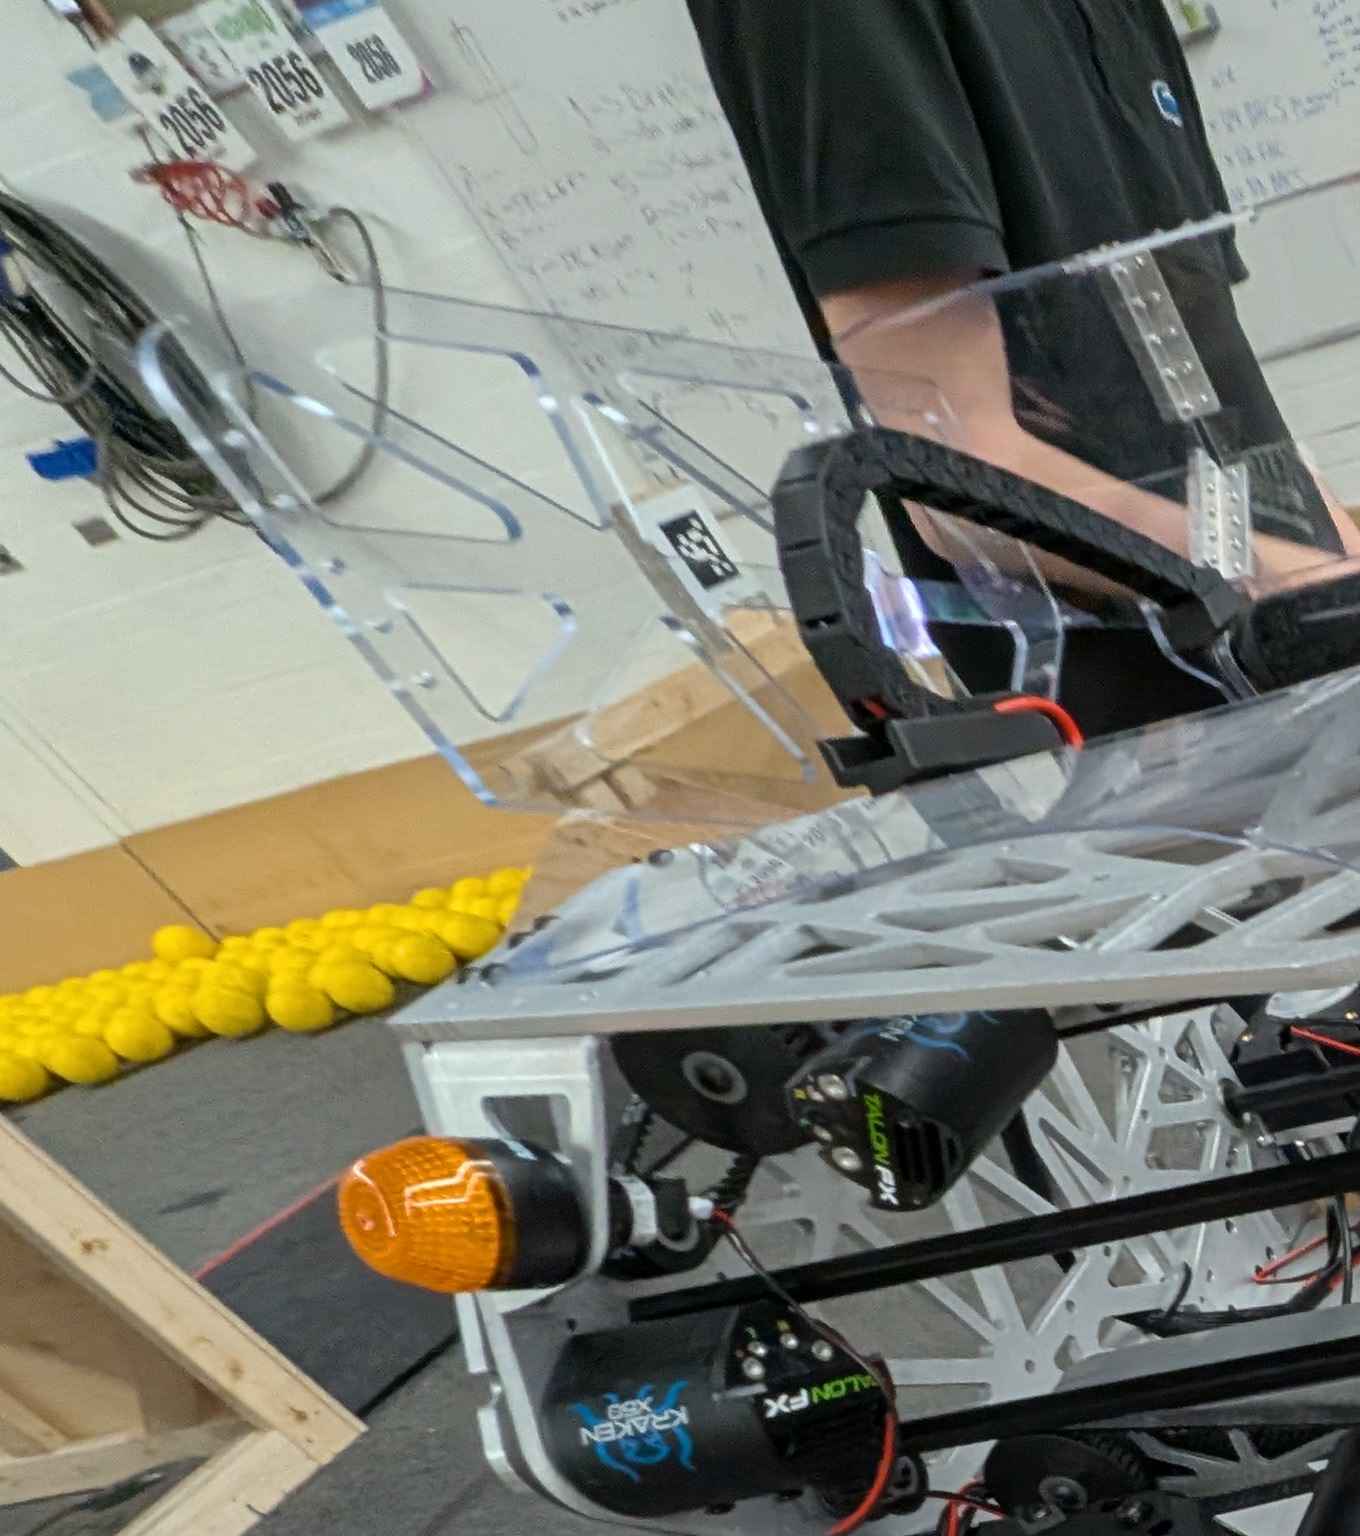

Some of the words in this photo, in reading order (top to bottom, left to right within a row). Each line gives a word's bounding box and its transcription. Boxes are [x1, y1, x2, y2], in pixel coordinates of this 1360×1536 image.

[247, 50, 324, 115] 2056
[159, 86, 226, 159] 2056
[578, 1405, 690, 1447] KRAKEN
